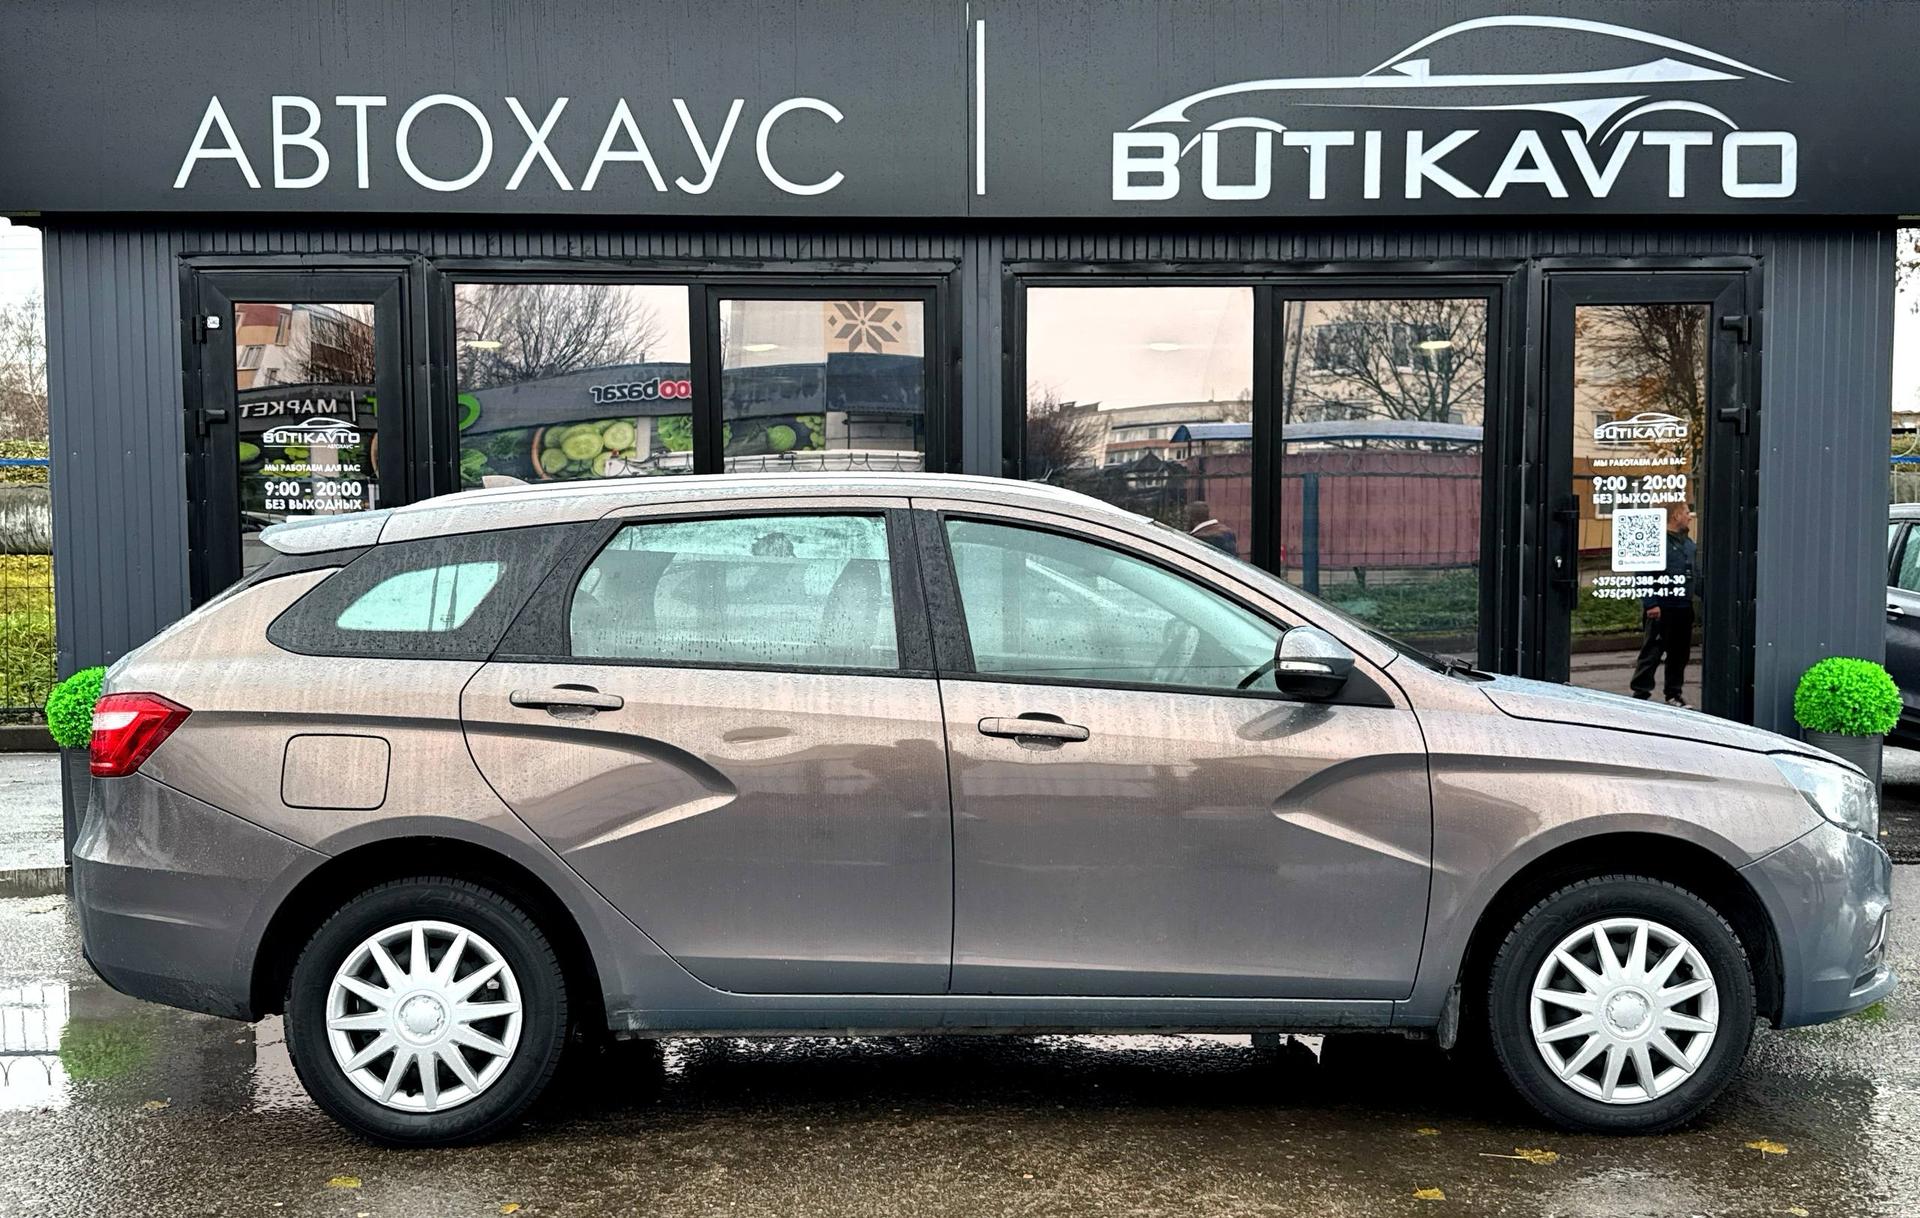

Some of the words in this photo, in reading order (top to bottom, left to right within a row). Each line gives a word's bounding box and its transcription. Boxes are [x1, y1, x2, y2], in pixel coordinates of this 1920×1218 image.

[172, 93, 846, 195] АВТОХАУС
[1111, 129, 1798, 201] BUTIKAVTO
[262, 432, 361, 444] BUTIKAVTO
[1593, 426, 1688, 439] BUTIKAVTO
[264, 464, 279, 472] МЫ
[280, 464, 324, 472] РАБОТАЕМ
[324, 464, 342, 473] ДЛЯ
[342, 464, 361, 472] ВАС
[1593, 459, 1608, 467] МЫ
[1609, 458, 1651, 467] РАБОТАЕМ
[1651, 458, 1668, 466] ДЛЯ
[1669, 457, 1686, 465] ВАС
[264, 481, 299, 496] 9:00
[316, 481, 362, 496] 20:00
[1592, 475, 1627, 490] 9:00
[1642, 474, 1687, 490] 20:00
[1592, 493, 1612, 504] БЕЗ
[1615, 492, 1686, 504] ВЫХОДНЫХ
[265, 499, 286, 510] БЕЗ
[288, 499, 362, 511] ВЫХОДНЫХ
[1592, 587, 1686, 600] +375(29)379-41-92
